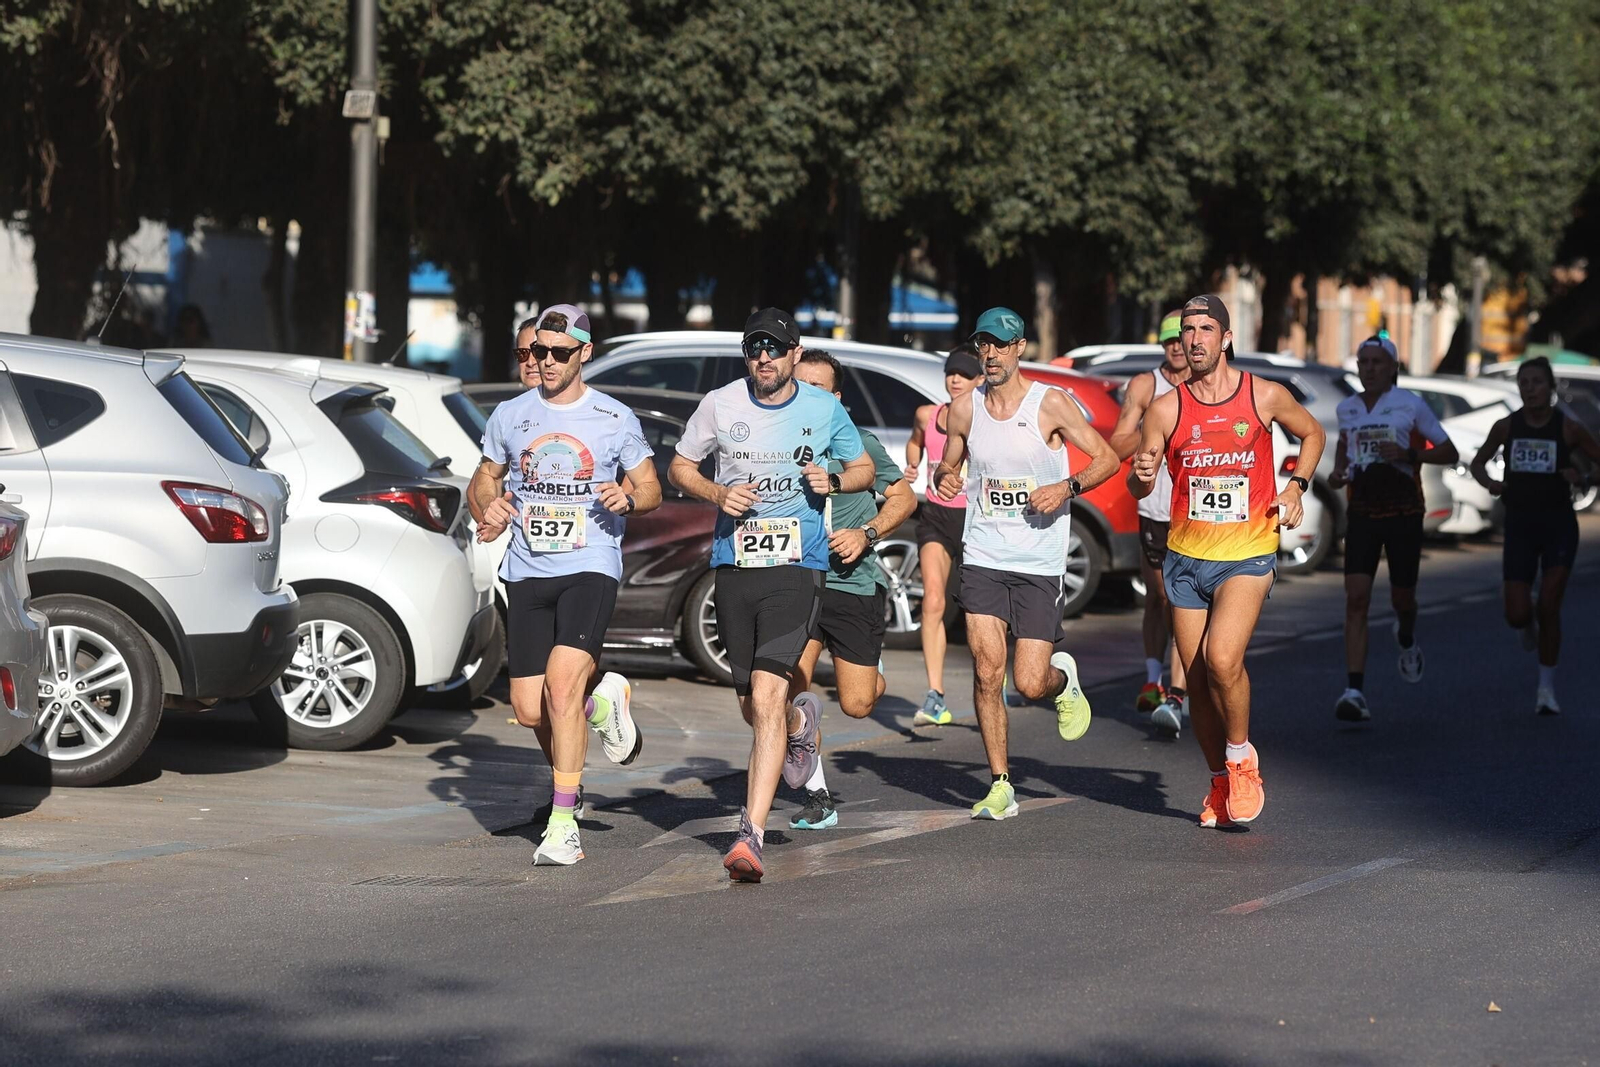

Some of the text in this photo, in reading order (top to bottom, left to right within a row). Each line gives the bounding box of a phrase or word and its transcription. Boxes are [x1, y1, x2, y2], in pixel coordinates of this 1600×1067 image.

[513, 422, 540, 430] MARBELLA
[1181, 448, 1212, 456] ATLETISMO
[1360, 441, 1379, 454] 72
[1516, 450, 1549, 462] 394
[990, 491, 1029, 506] 690
[1202, 492, 1232, 509] 49
[530, 520, 574, 537] 537
[743, 533, 791, 553] 247
